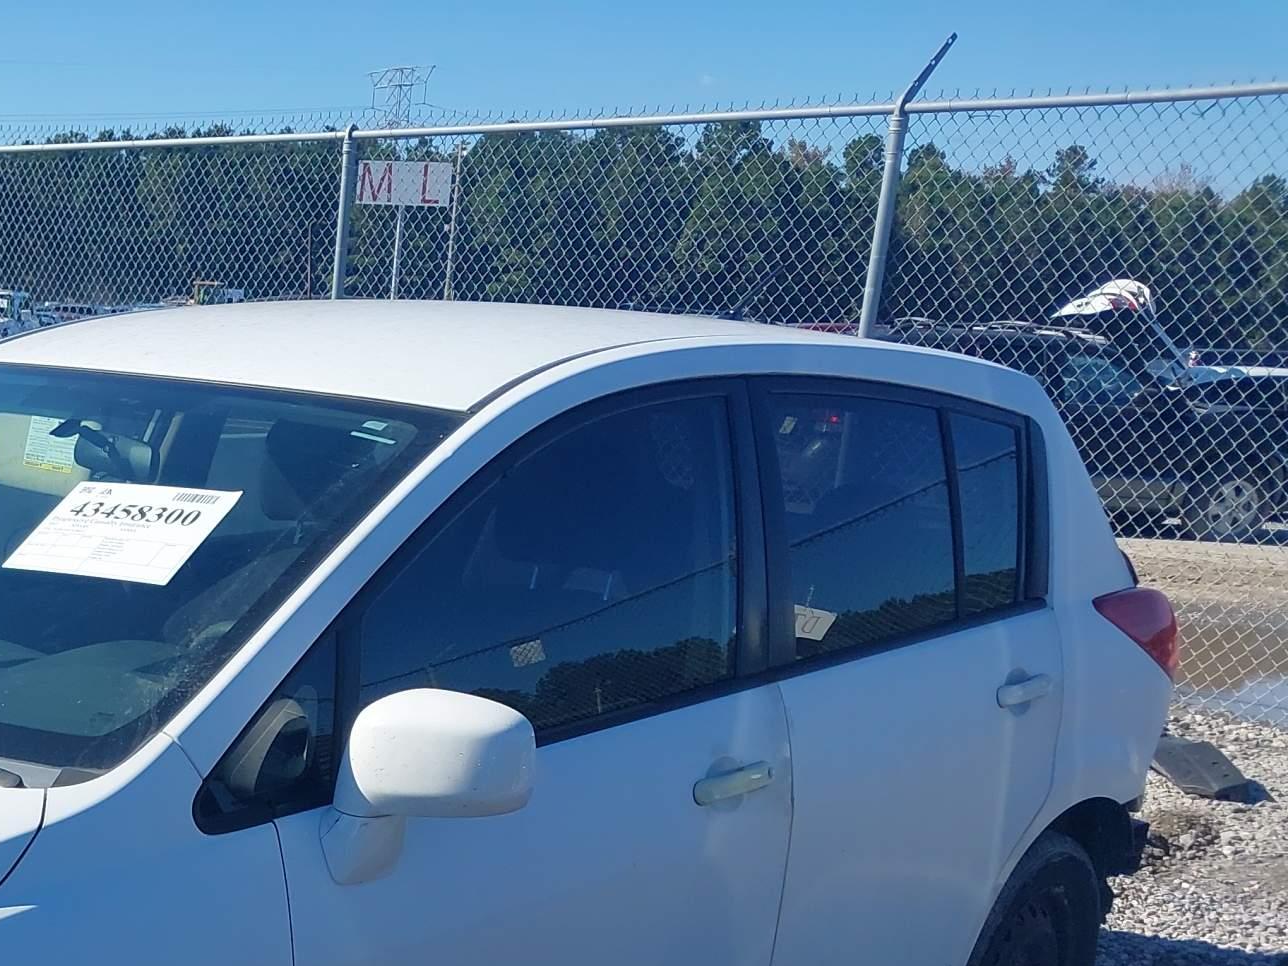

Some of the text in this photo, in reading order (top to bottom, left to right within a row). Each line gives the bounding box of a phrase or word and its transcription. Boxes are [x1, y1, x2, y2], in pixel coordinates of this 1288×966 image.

[359, 163, 440, 204] M L
[70, 501, 201, 526] 43458300
